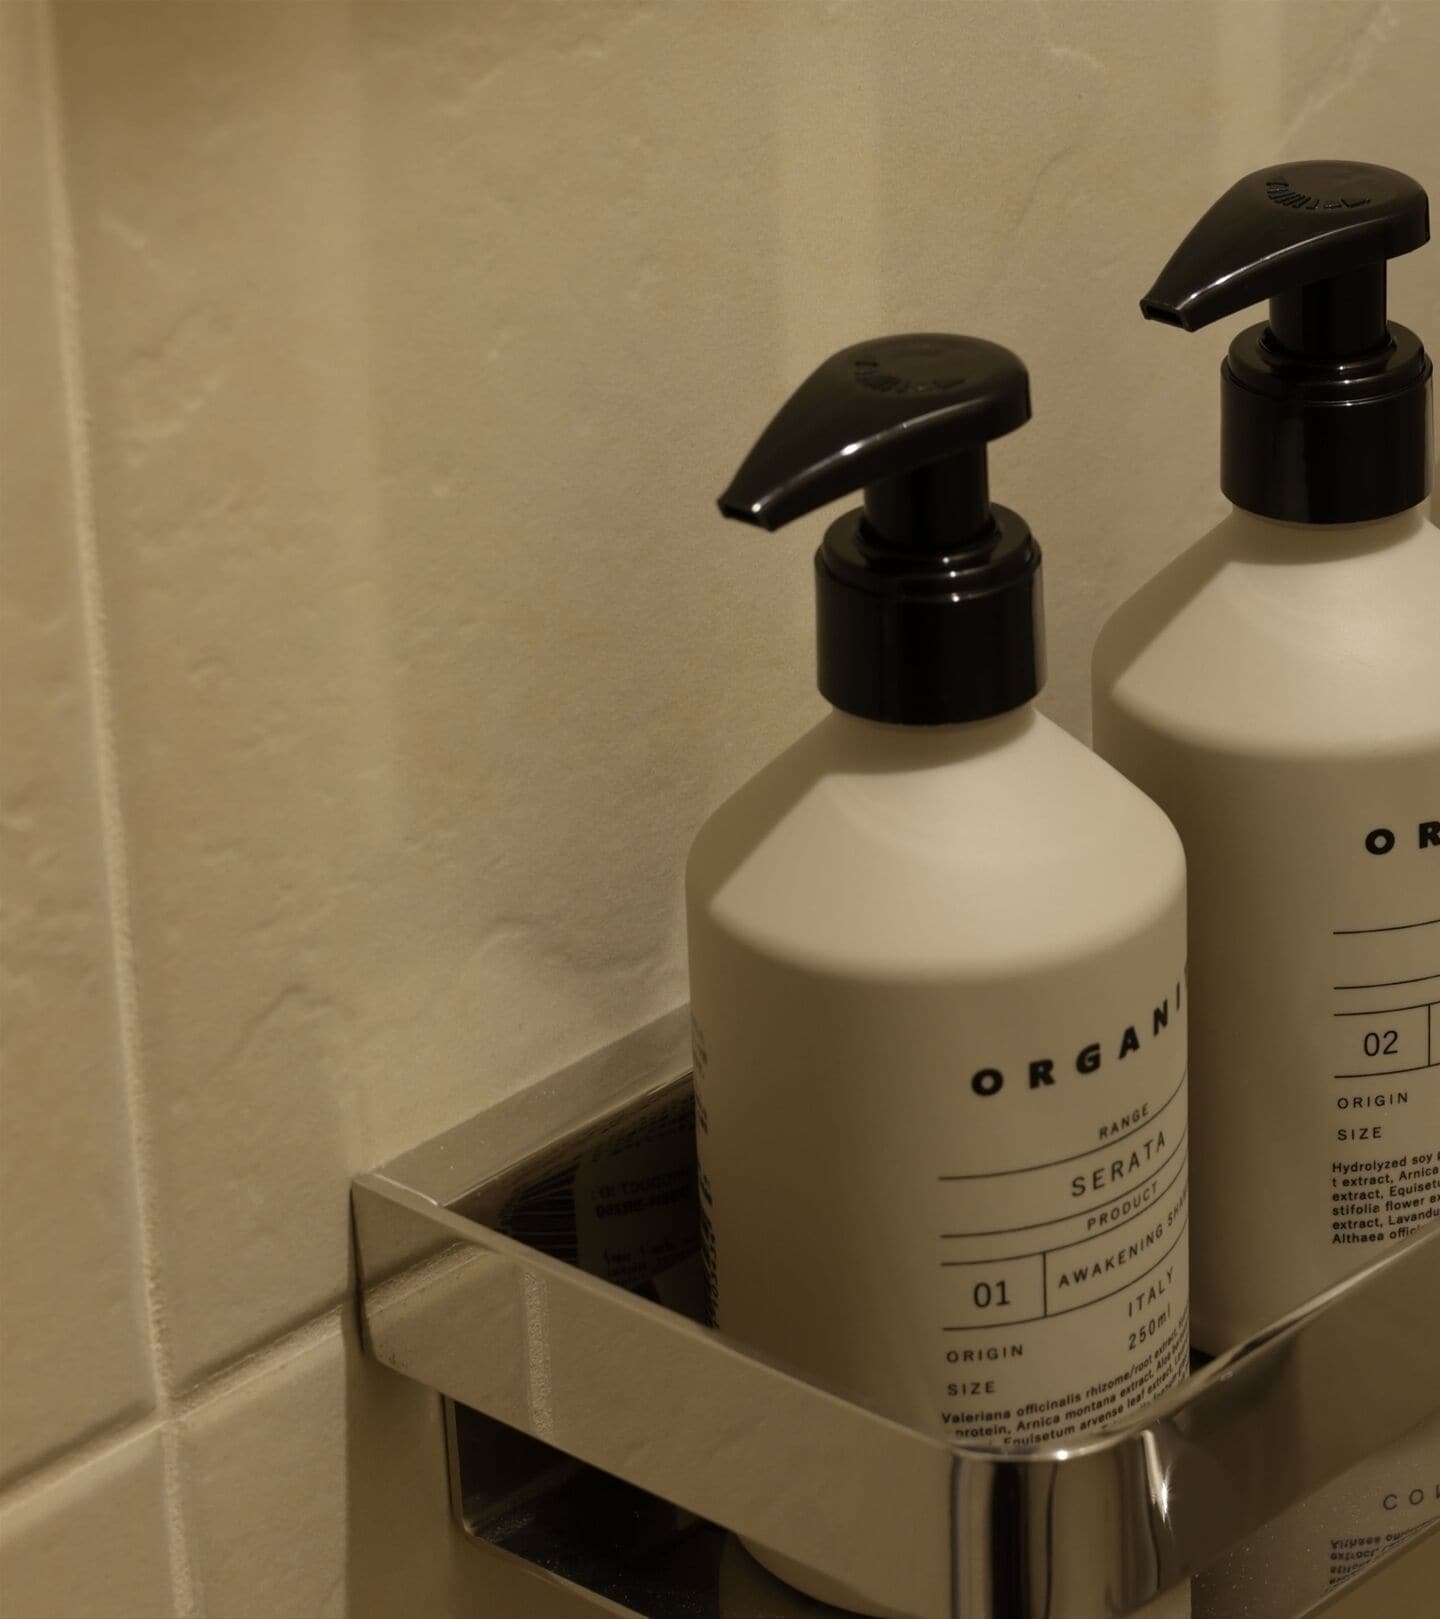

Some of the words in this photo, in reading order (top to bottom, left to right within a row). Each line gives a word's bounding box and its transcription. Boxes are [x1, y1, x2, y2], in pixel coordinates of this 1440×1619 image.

[1364, 1030, 1398, 1056] 02
[1337, 1092, 1408, 1109] ORIGIN
[1099, 1102, 1149, 1140] RANGE
[1337, 1126, 1382, 1141] SIZE
[1071, 1131, 1165, 1198] SERATA
[1332, 1156, 1407, 1175] Hydrolyzed
[1412, 1152, 1433, 1166] soy
[1342, 1173, 1394, 1188] extract,
[1399, 1165, 1439, 1182] Arnica
[1087, 1181, 1158, 1231] PRODUCT
[1332, 1189, 1384, 1202] extract,
[1332, 1201, 1380, 1217] stifolia
[1385, 1196, 1426, 1213] flower
[1332, 1215, 1383, 1230] extract,
[1332, 1231, 1384, 1245] Althaea
[1058, 1224, 1163, 1288] AWAKENING
[974, 1281, 1010, 1308] 01
[1129, 1266, 1174, 1317] ITALY
[1129, 1303, 1171, 1350] 250ml
[947, 1344, 1023, 1363] ORIGIN
[941, 1410, 1011, 1424] Valeriana
[1016, 1393, 1081, 1417] officinalis
[1086, 1357, 1152, 1399] rhizome/root
[948, 1381, 995, 1396] SIZE
[1017, 1415, 1060, 1433] Arnica
[1065, 1394, 1116, 1419] montana
[1080, 1405, 1124, 1431] arvense
[1127, 1390, 1145, 1410] leaf
